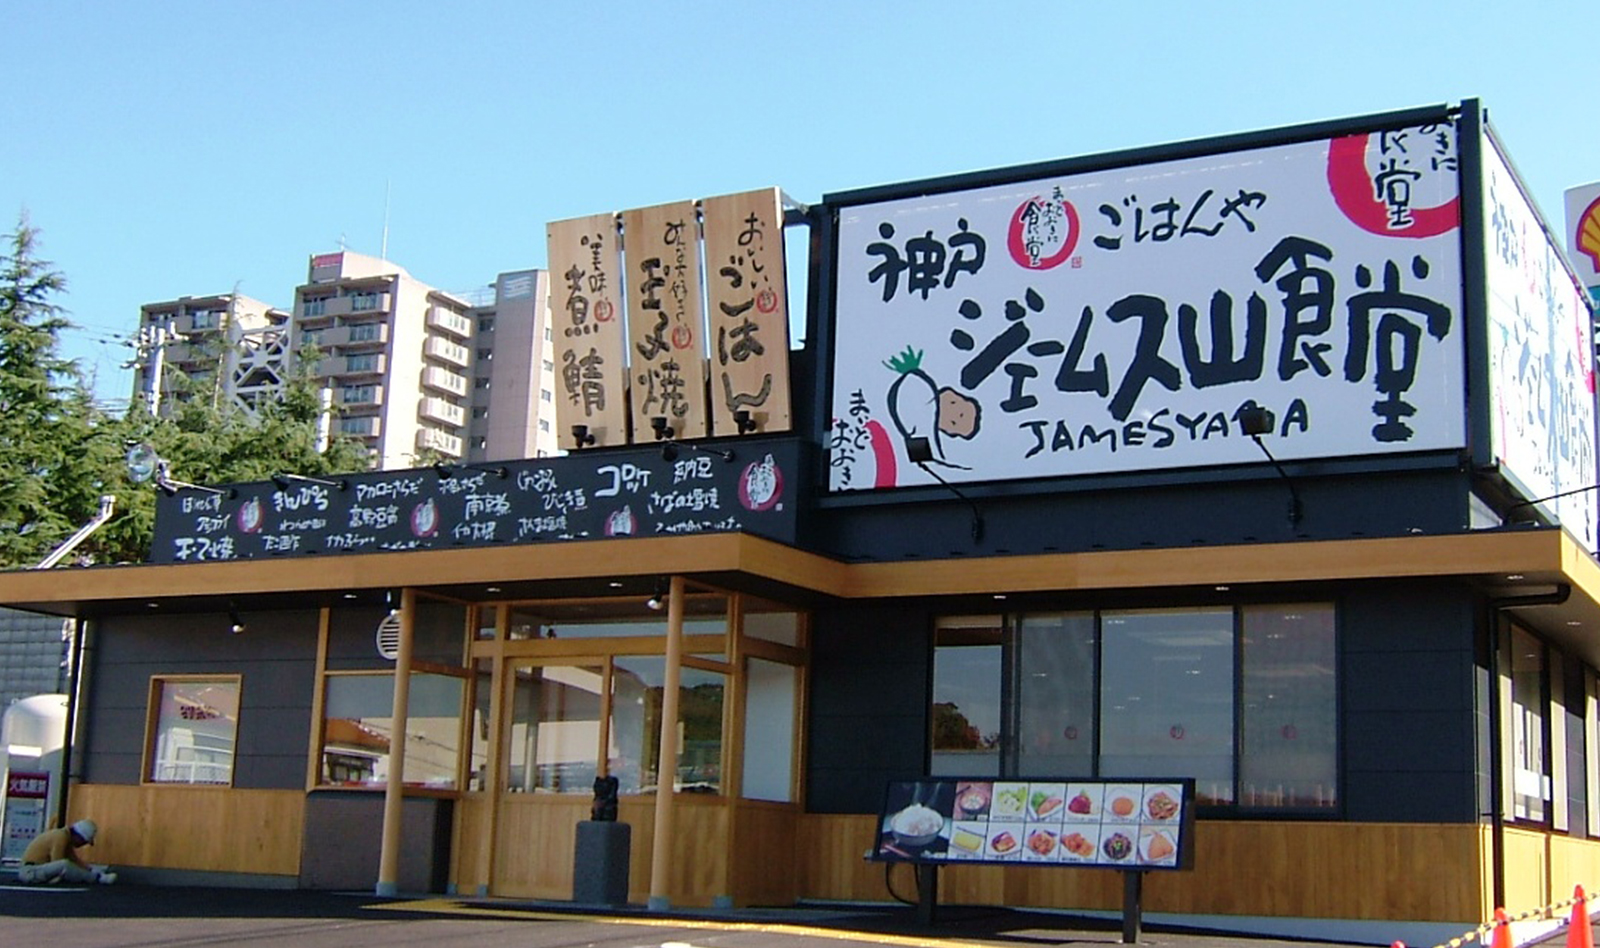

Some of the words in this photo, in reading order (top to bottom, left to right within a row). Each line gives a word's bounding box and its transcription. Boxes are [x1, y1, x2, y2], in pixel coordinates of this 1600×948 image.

[737, 211, 769, 291] おいしい
[1021, 201, 1044, 265] 食堂
[1093, 188, 1266, 251] ごはんや
[866, 220, 986, 302] 神戸
[636, 257, 689, 418] 玉子焼
[718, 254, 772, 415] ごはん
[949, 234, 1453, 444] ジェームス山食堂
[830, 419, 856, 491] おおき
[1018, 398, 1310, 459] JAMESYAA
[273, 485, 329, 512] きんぴら
[594, 463, 652, 498] コロッケ
[673, 456, 714, 485] 納豆
